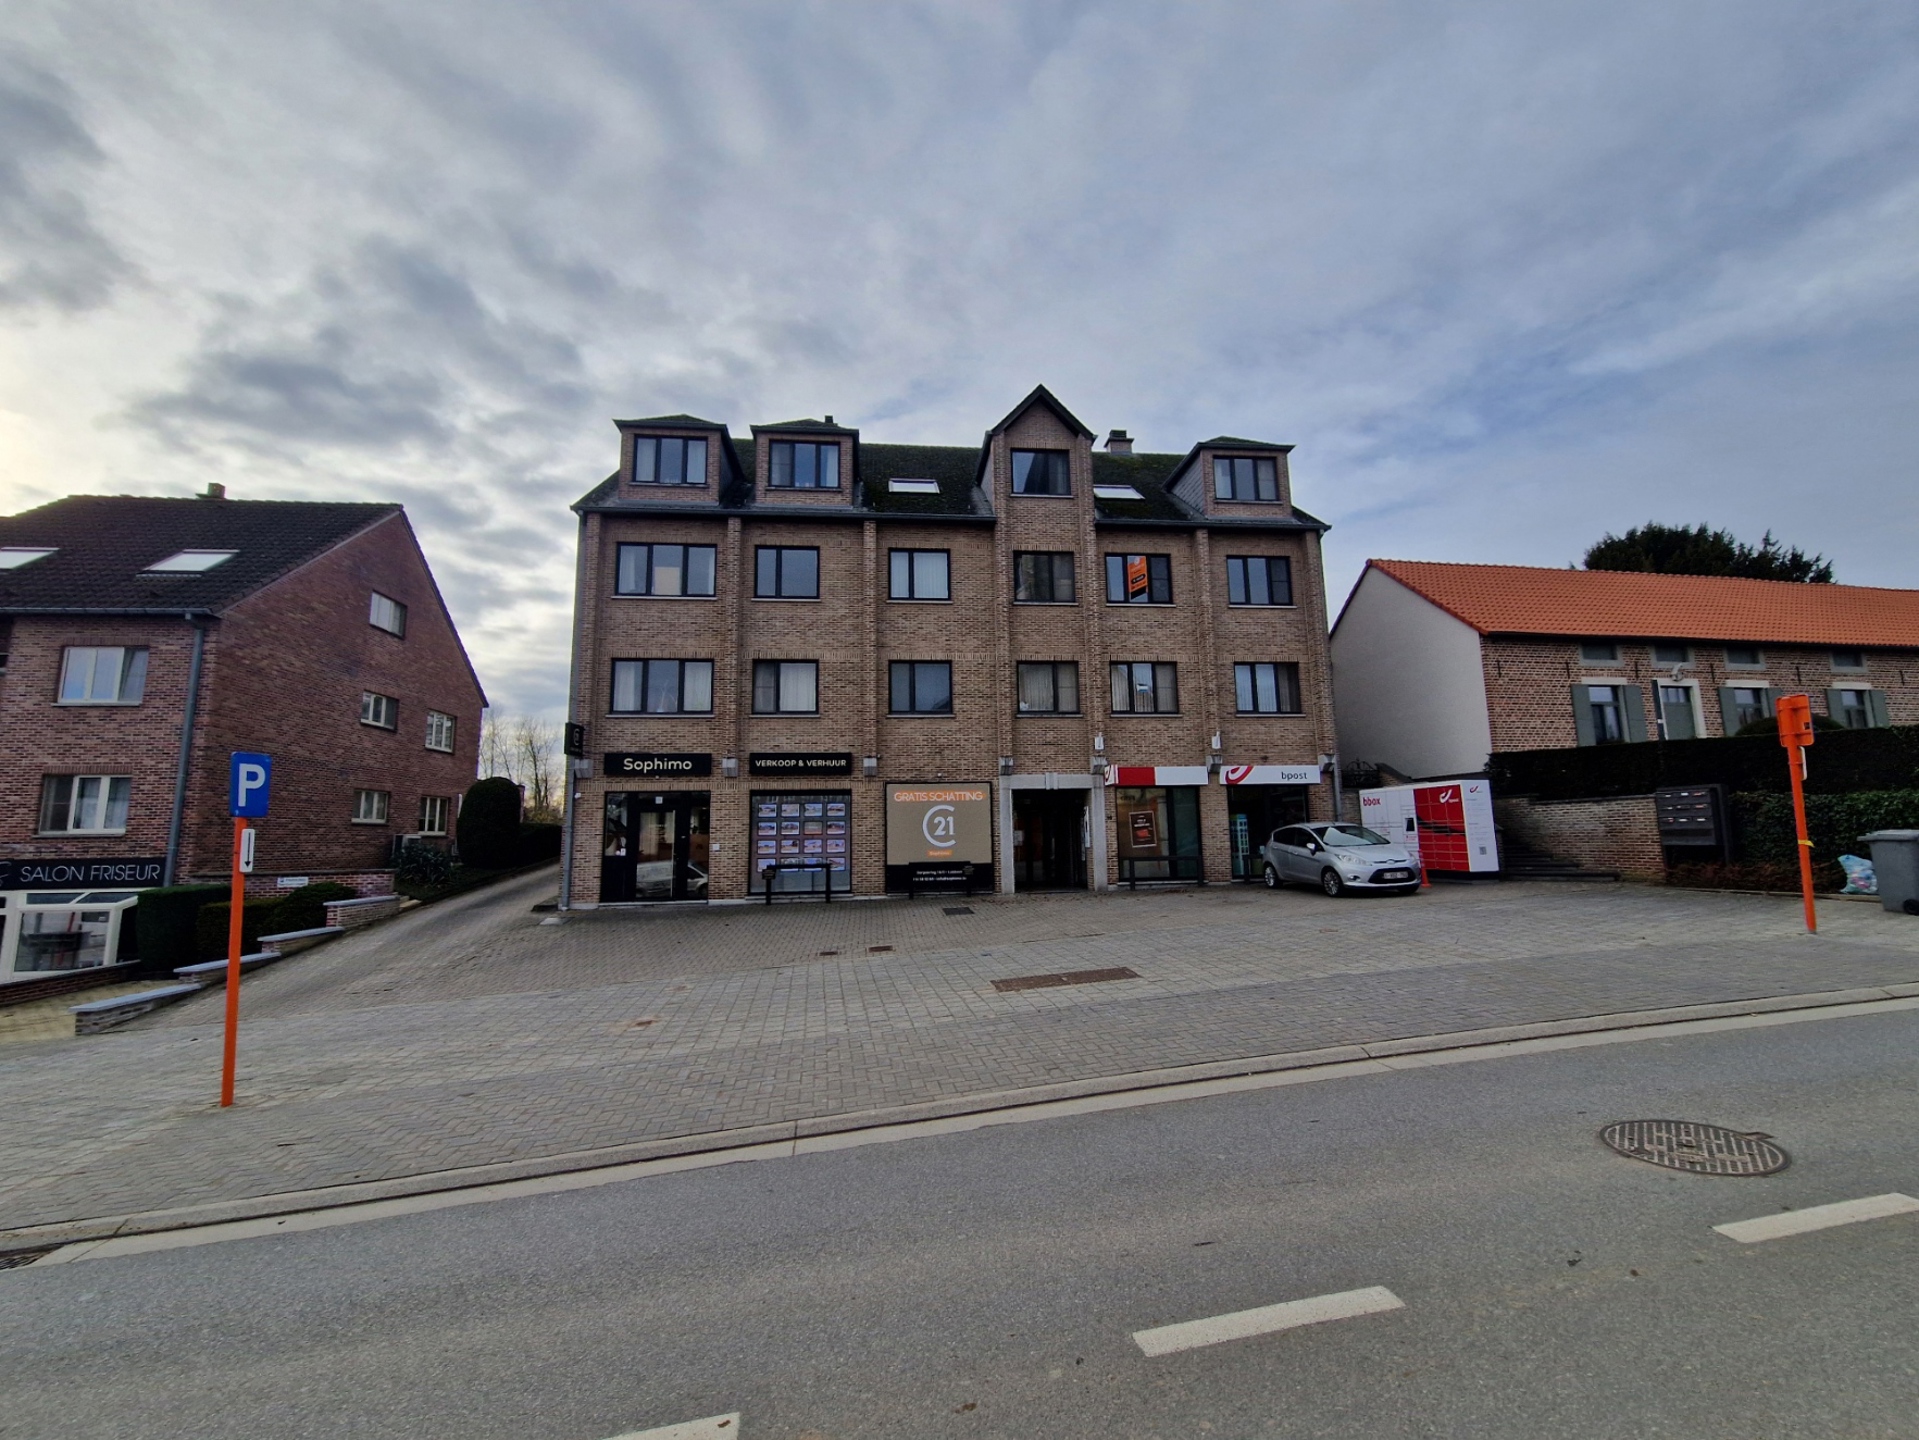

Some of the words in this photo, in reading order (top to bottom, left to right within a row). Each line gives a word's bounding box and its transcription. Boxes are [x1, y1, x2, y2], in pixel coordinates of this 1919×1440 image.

[623, 758, 692, 774] Sophimo
[755, 759, 797, 768] VERKOOP
[798, 759, 804, 767] &
[806, 759, 847, 767] VERHUUR
[1281, 771, 1308, 781] bpost
[238, 762, 266, 807] P
[894, 792, 927, 802] GRATIS
[929, 791, 983, 801] SCHATTING
[1362, 797, 1382, 807] bbox
[20, 865, 85, 882] SALON
[90, 864, 161, 881] FRISEUR
